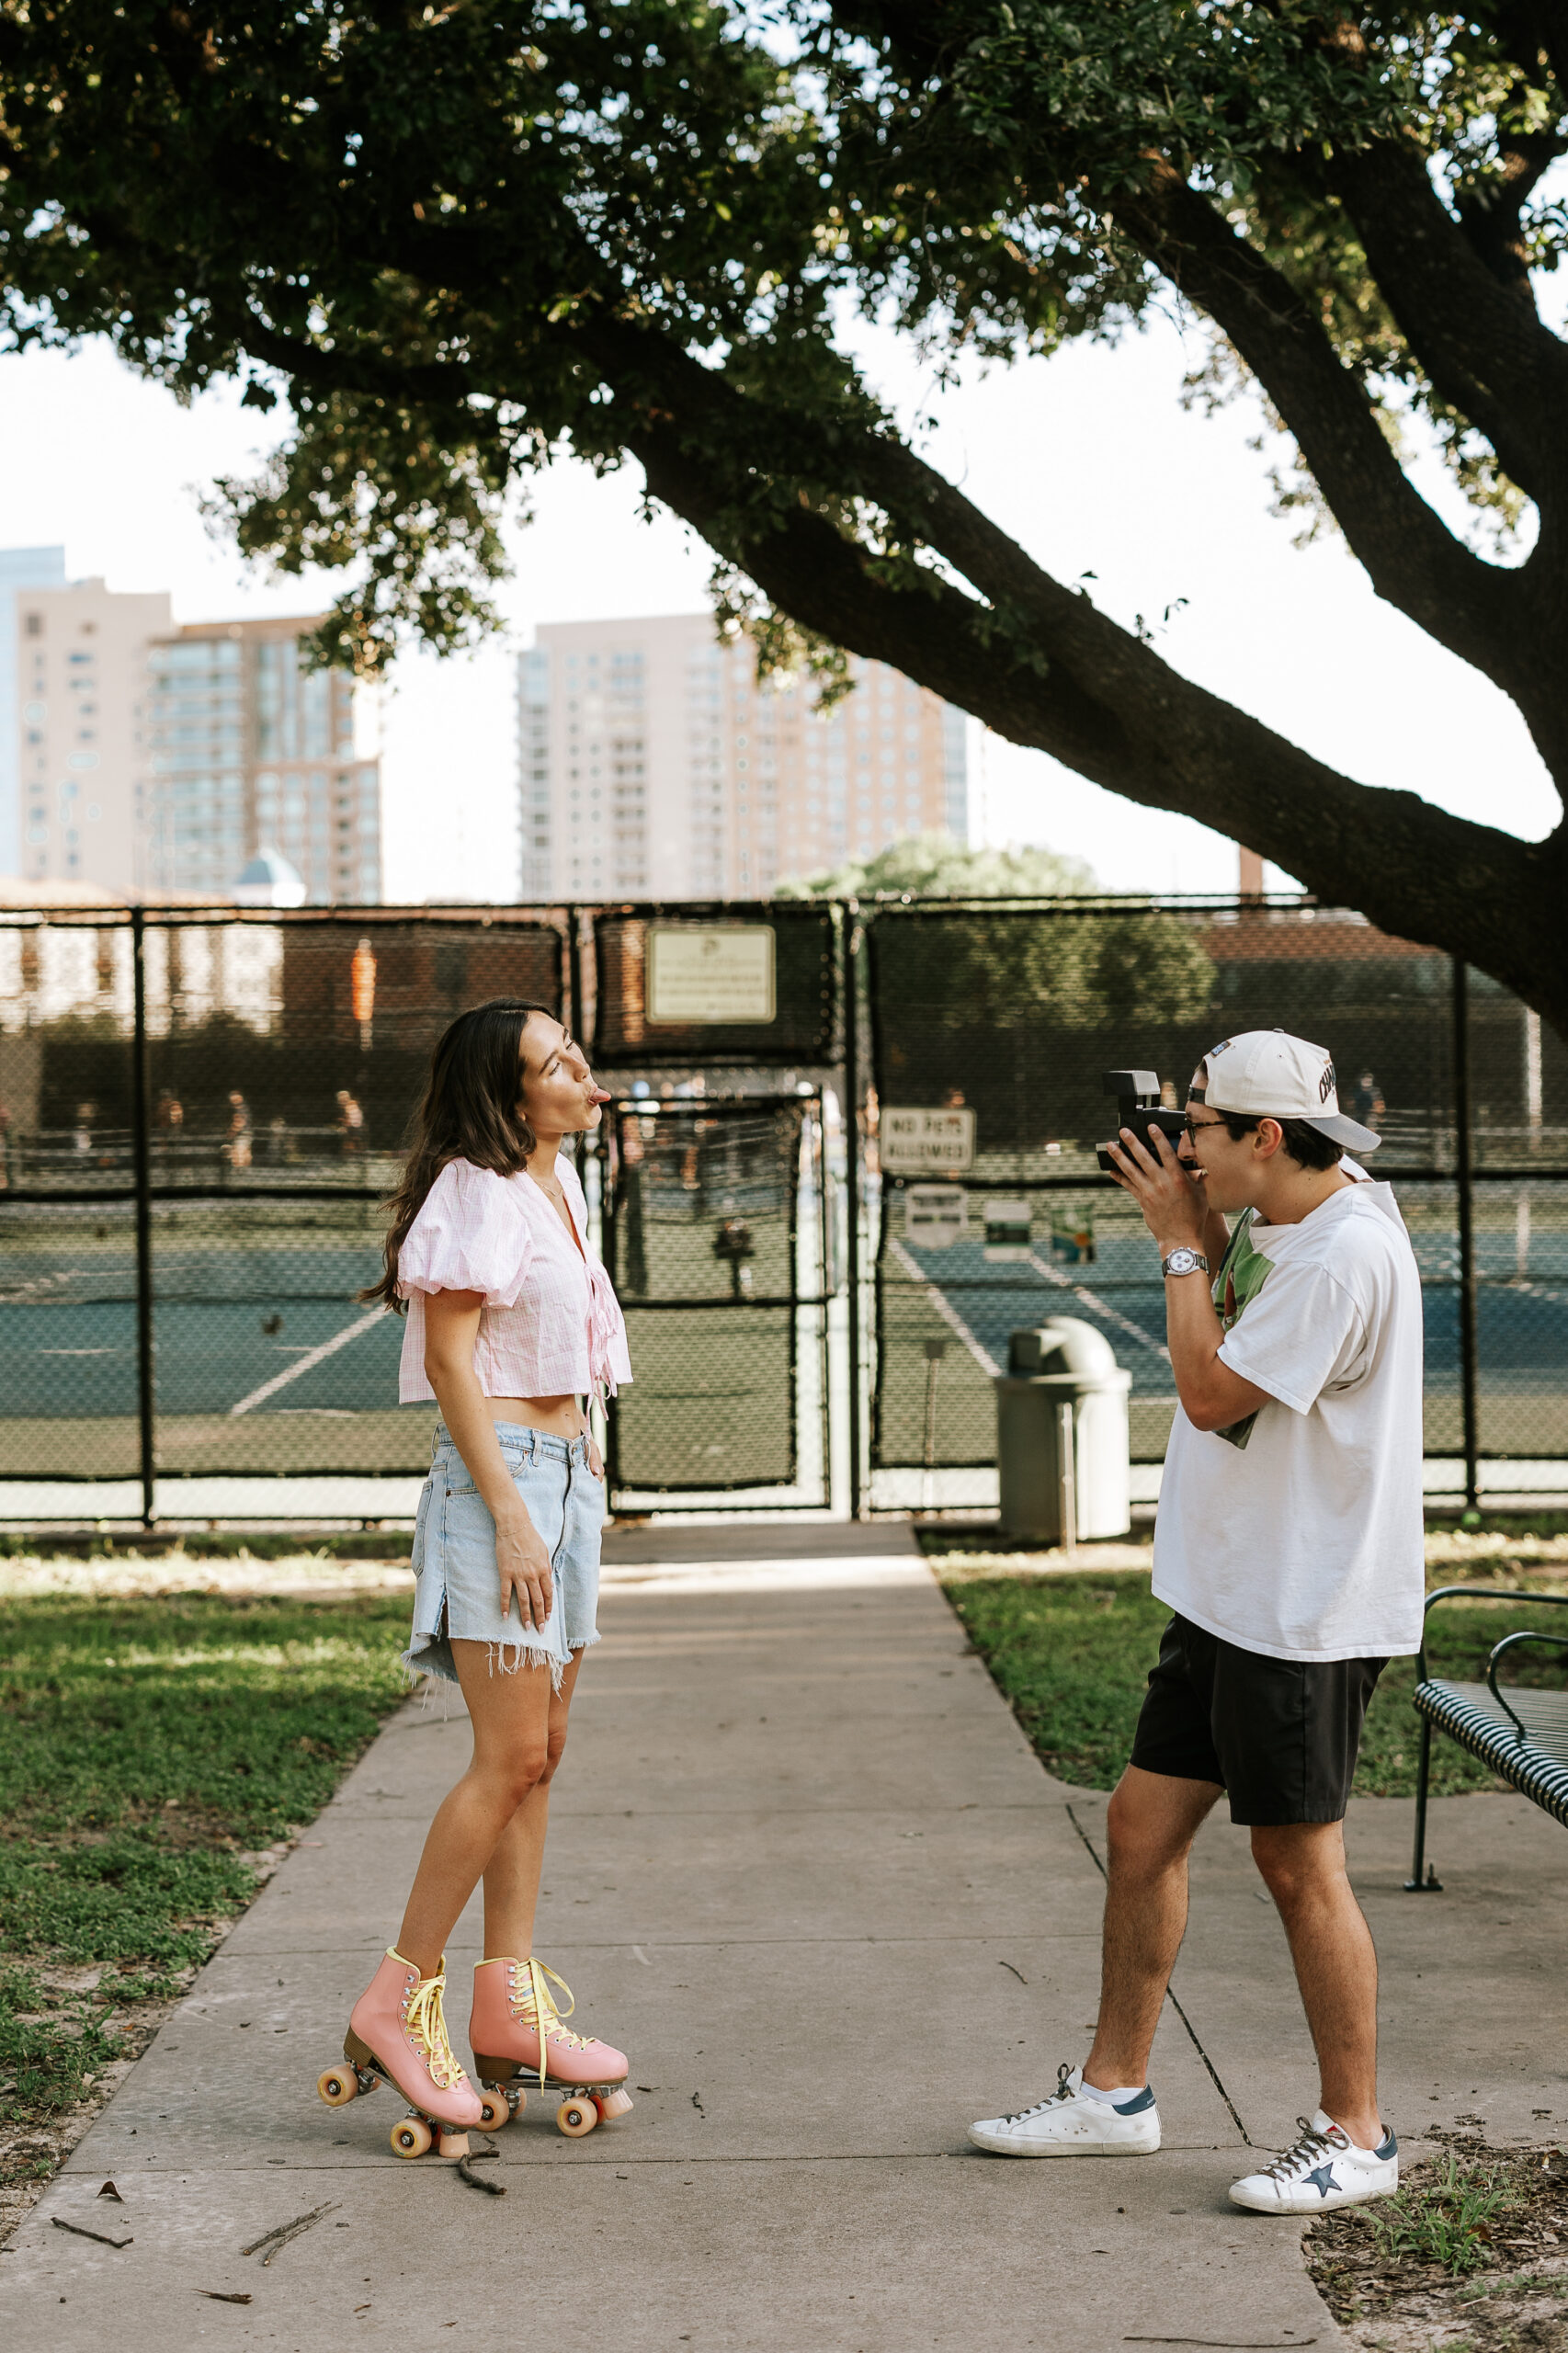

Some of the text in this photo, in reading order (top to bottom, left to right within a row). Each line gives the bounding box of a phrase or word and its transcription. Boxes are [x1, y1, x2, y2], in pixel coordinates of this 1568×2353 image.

[890, 1116, 964, 1135] NO PETS
[887, 1142, 968, 1160] ALLOWED
